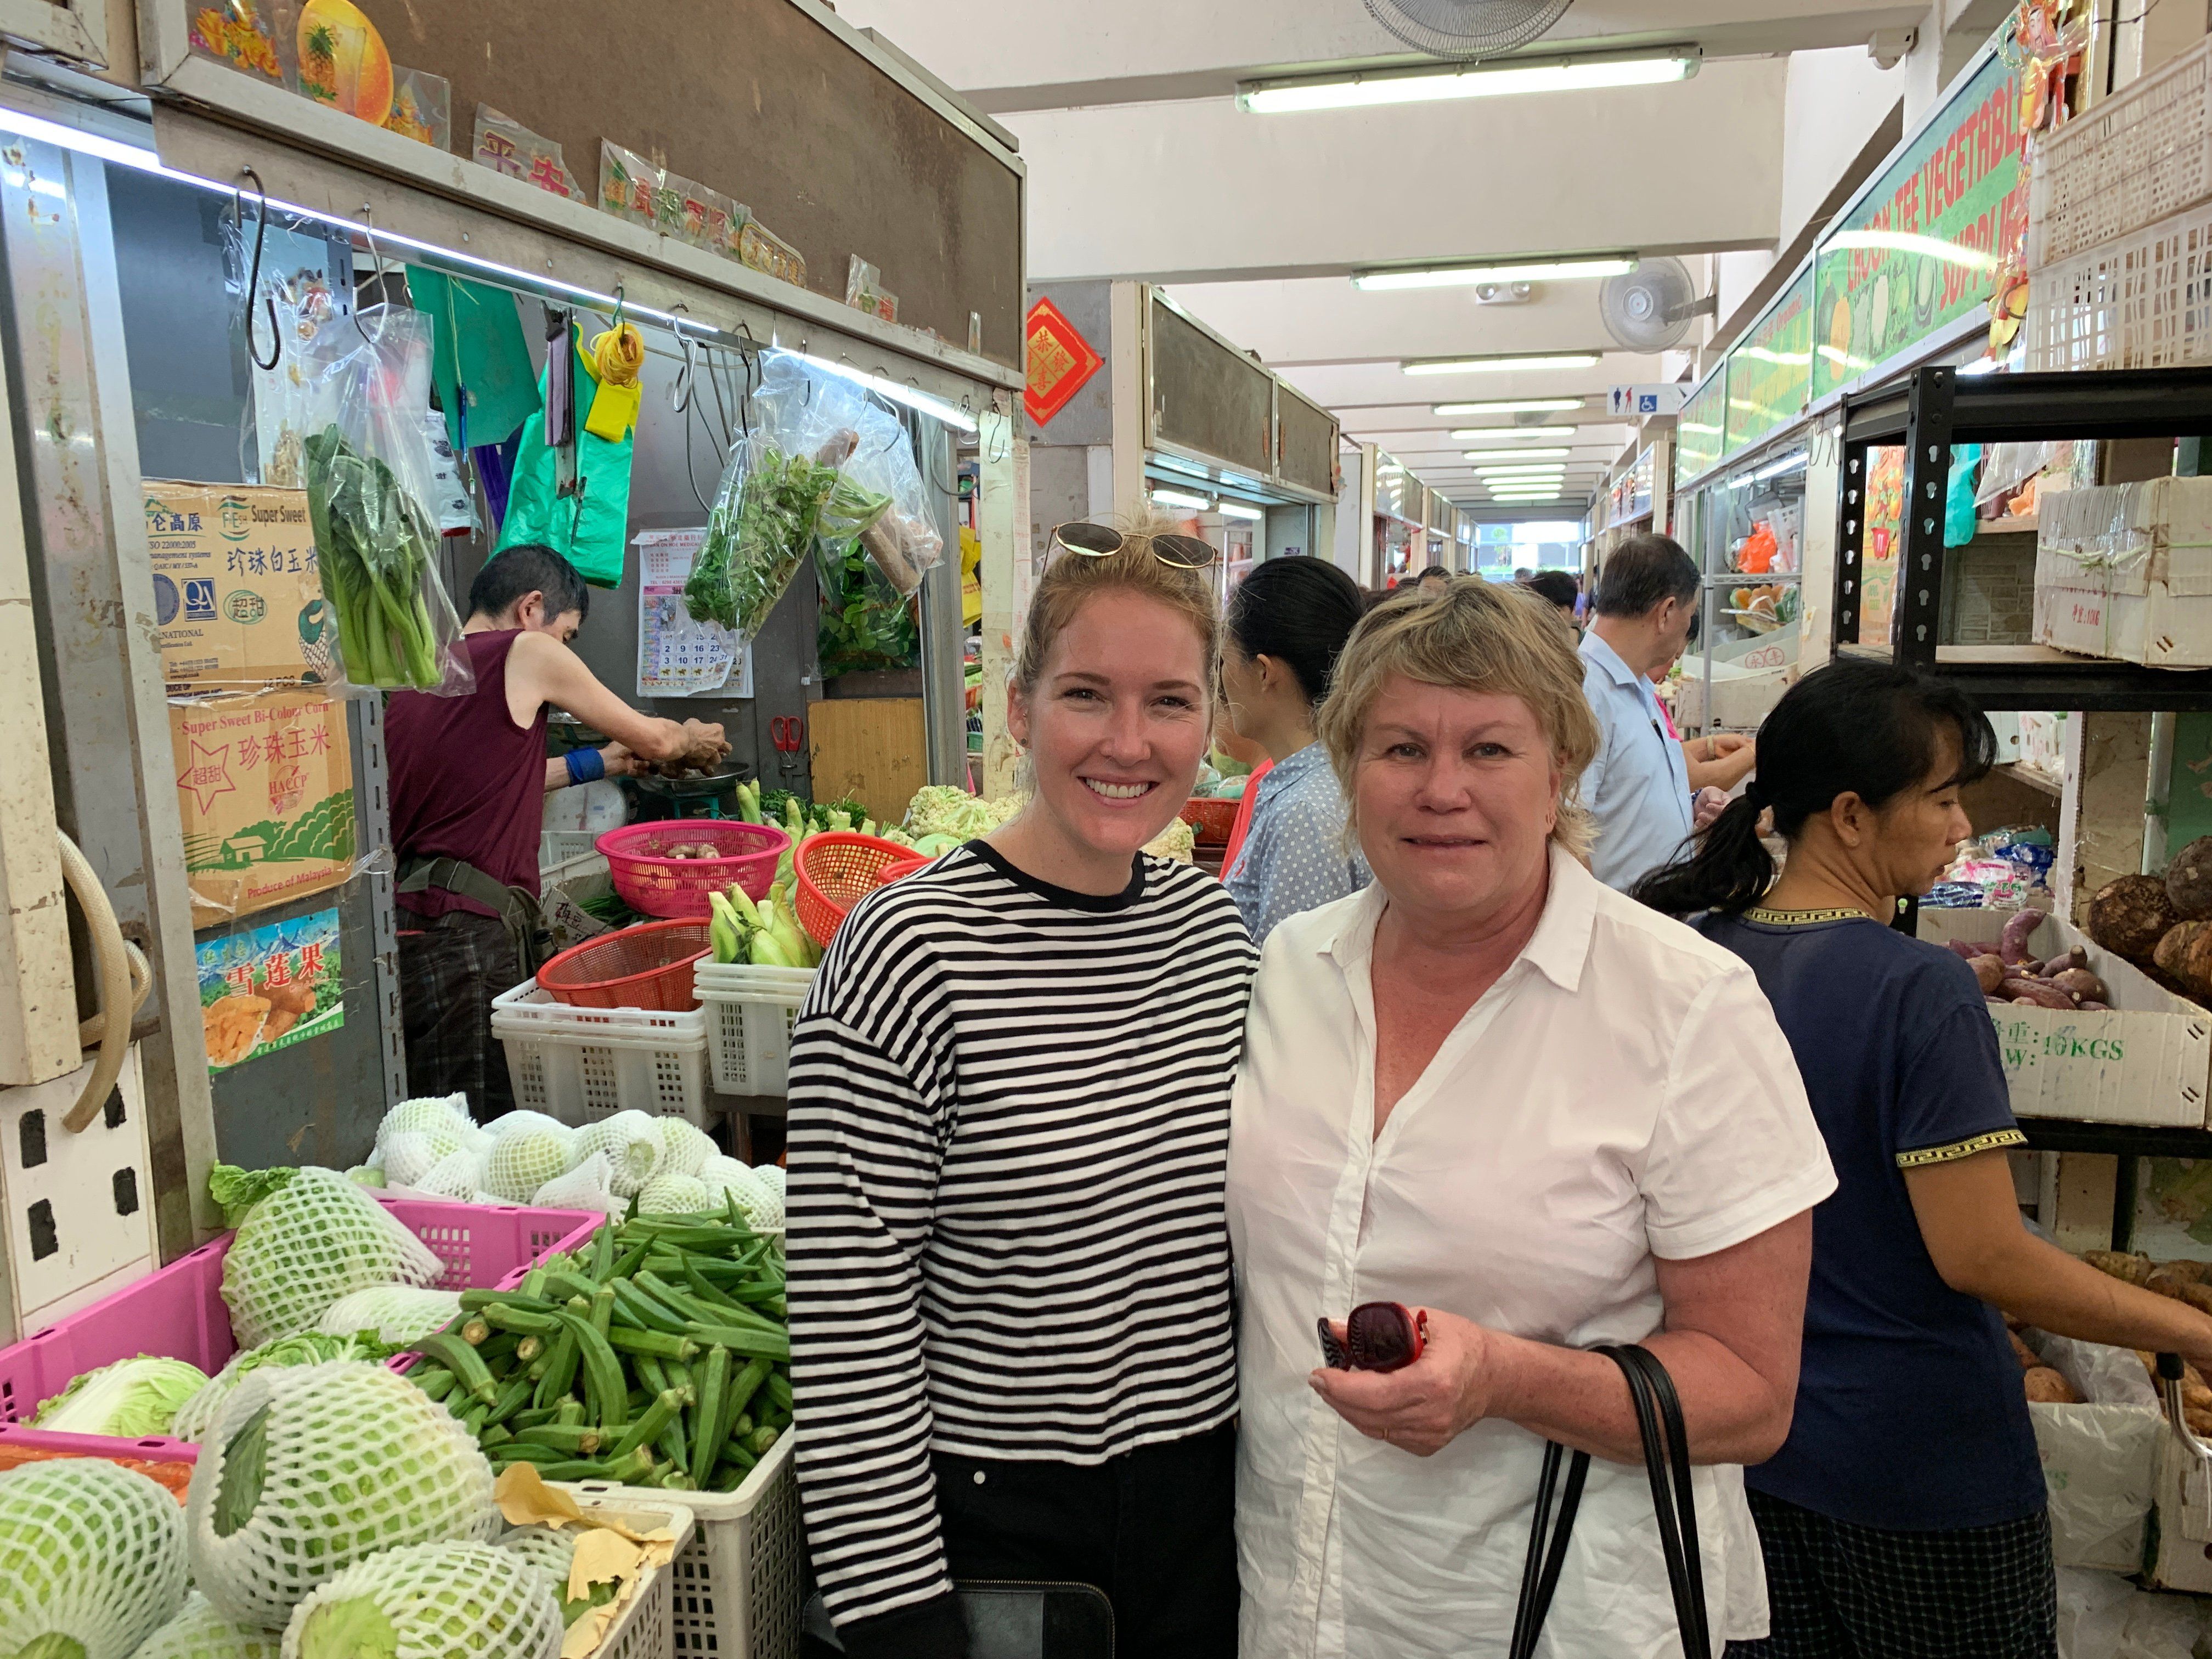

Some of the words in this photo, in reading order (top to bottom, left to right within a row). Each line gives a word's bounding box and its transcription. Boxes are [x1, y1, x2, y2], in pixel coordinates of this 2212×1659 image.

[478, 129, 571, 198] 平安
[1894, 170, 1919, 234] TEE
[1776, 294, 1802, 332] Organic
[145, 512, 203, 532] 仑高原
[251, 504, 278, 527] Super
[280, 505, 306, 522] Sweet
[182, 720, 217, 736] Super
[220, 714, 251, 729] Sweet
[254, 706, 301, 724] Bi-Colour
[304, 702, 329, 714] Corn
[237, 723, 331, 771] 珍珠玉米
[193, 764, 222, 786] 超甜
[268, 774, 307, 794] HACCP
[247, 882, 284, 899] Produce
[285, 875, 294, 887] of
[297, 866, 332, 884] Malaysia
